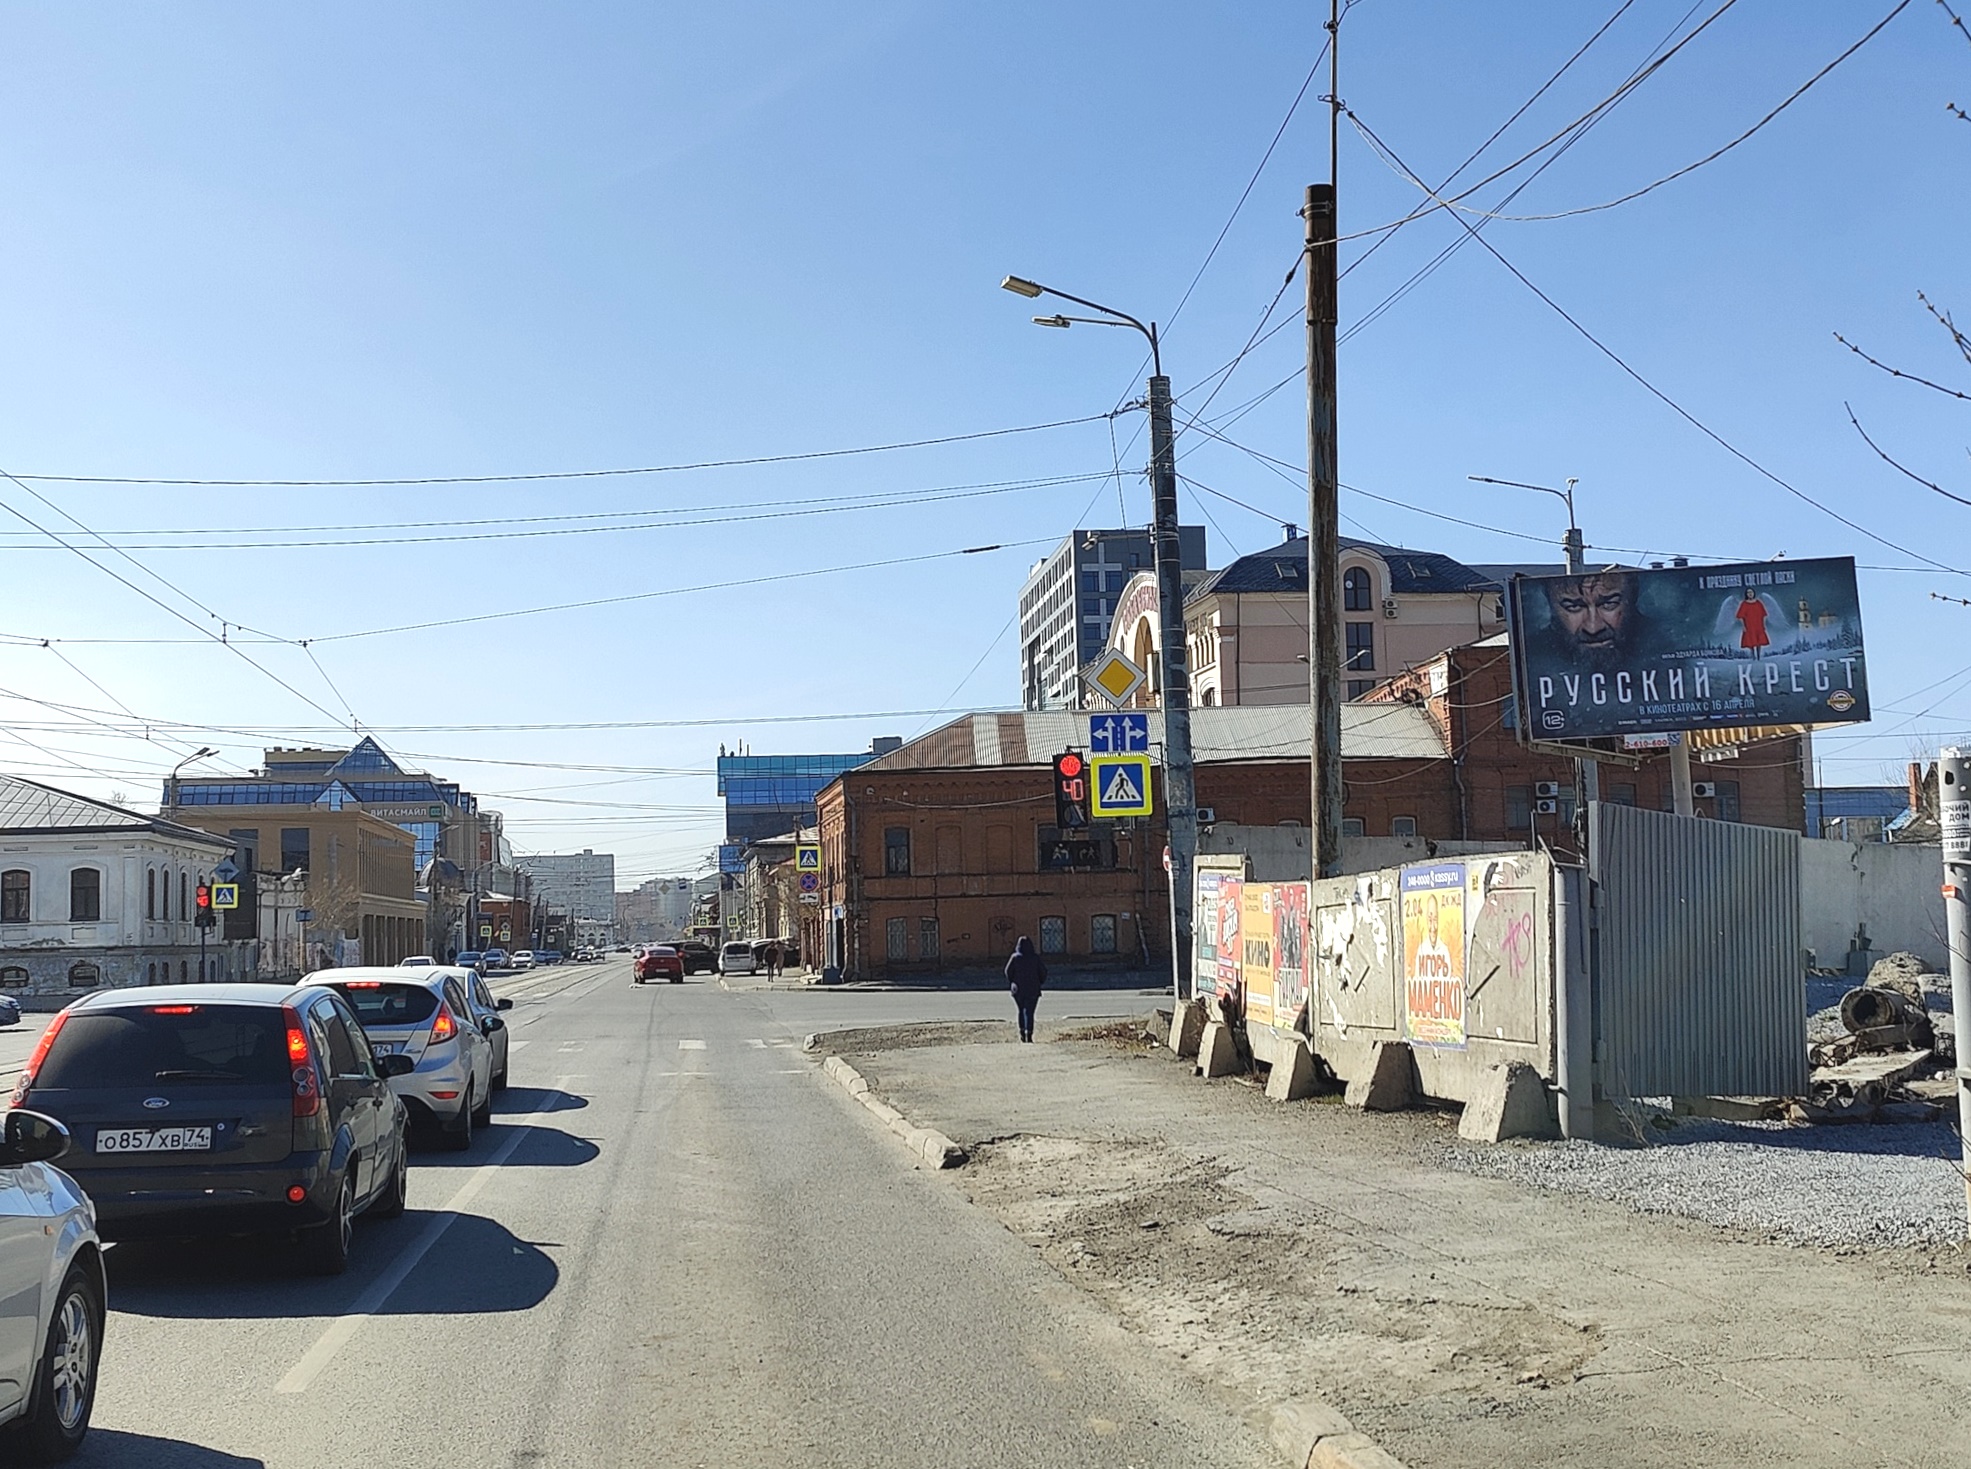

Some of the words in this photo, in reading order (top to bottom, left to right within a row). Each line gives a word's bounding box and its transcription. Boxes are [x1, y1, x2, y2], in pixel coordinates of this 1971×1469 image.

[1539, 662, 1710, 708] РУССКИЙ
[1738, 658, 1857, 696] КРЕСТ
[1639, 706, 1646, 715] В
[1647, 702, 1701, 714] КИНОТЕАТРАХ
[1703, 702, 1709, 711] С
[1712, 700, 1721, 710] 16
[1724, 699, 1755, 710] АПРЕЛЯ
[1625, 740, 1667, 748] 2-610-600
[1063, 779, 1083, 801] 40
[371, 807, 427, 817] ВИТАСМАЙЛ
[1949, 812, 1970, 822] ДОМ
[1404, 898, 1422, 918] 2.04
[1246, 939, 1270, 968] КИНО
[1418, 954, 1449, 977] ИГОРЬ
[1408, 980, 1462, 1020] МАМЕНКО
[186, 1129, 205, 1142] 74
